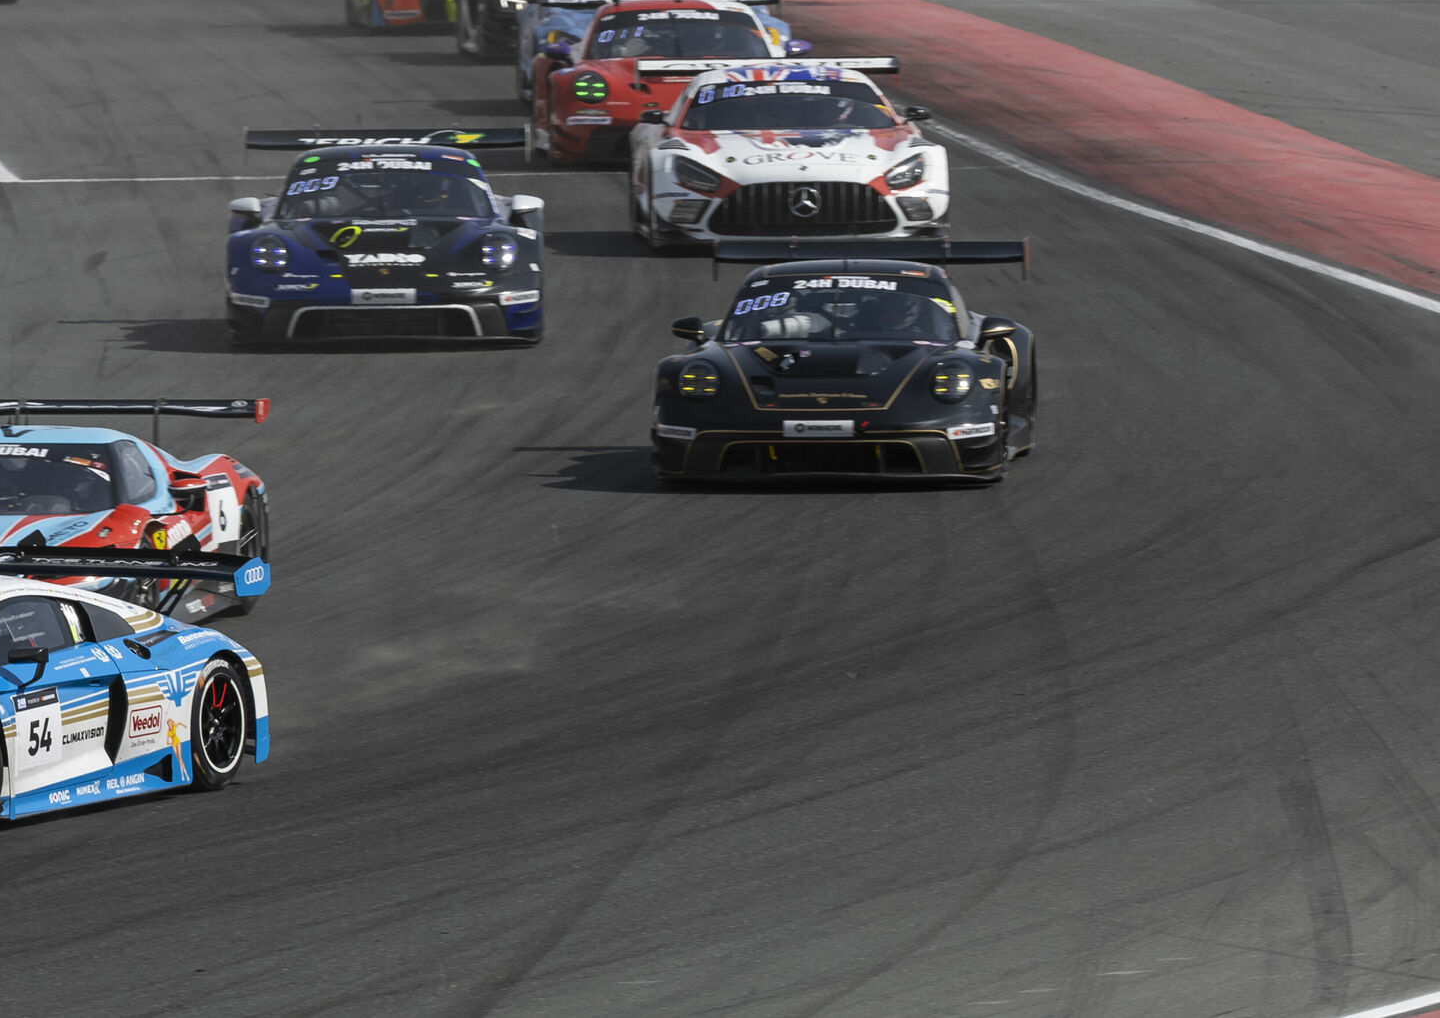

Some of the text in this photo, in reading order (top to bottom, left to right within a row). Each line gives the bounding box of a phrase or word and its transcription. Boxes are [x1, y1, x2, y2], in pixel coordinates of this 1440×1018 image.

[742, 151, 858, 165] GROVE
[286, 176, 340, 196] 009
[793, 280, 898, 291] 24H DUBAI
[733, 291, 791, 315] 008
[219, 500, 226, 531] 6
[132, 712, 160, 731] Veedol
[28, 717, 52, 756] 54
[62, 726, 105, 745] CLIMAXVISION
[48, 789, 70, 804] SONIC
